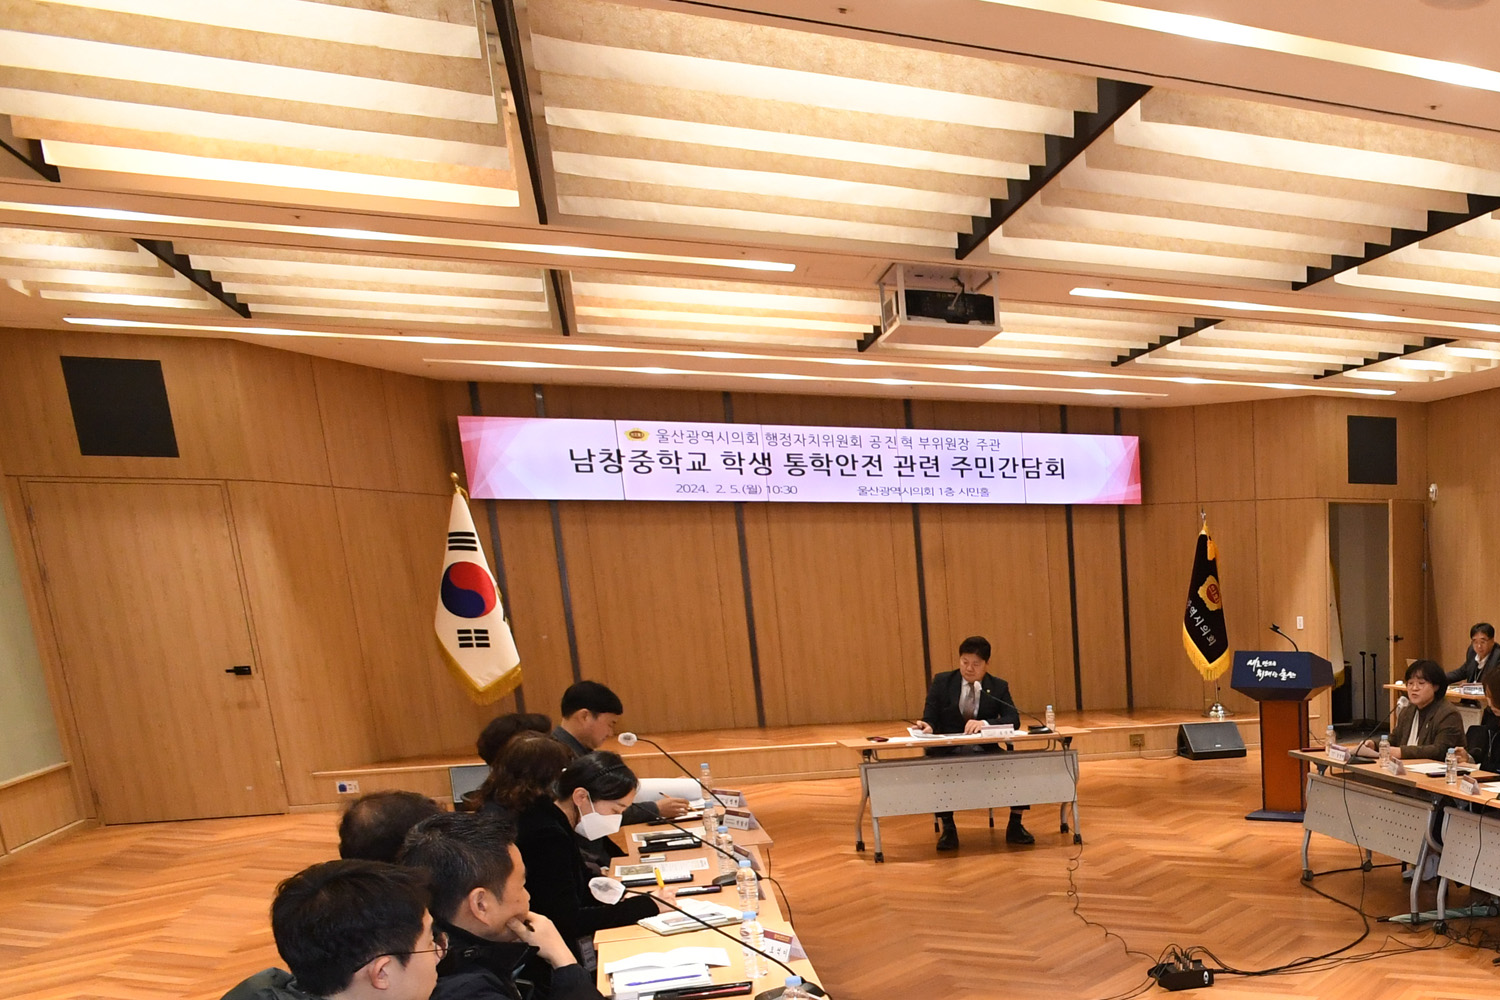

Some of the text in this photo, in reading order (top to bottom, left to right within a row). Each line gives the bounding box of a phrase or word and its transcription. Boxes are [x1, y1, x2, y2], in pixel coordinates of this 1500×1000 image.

[656, 428, 759, 446] 울산광역시의회
[765, 432, 863, 450] 행정자치위원회
[918, 437, 970, 452] 부위원장
[976, 438, 1001, 453] 주관
[569, 448, 1066, 480] 남창중학교 학생 통학안전 관련 주민간담회
[675, 484, 710, 494] 2024.
[766, 485, 798, 495] 10:30
